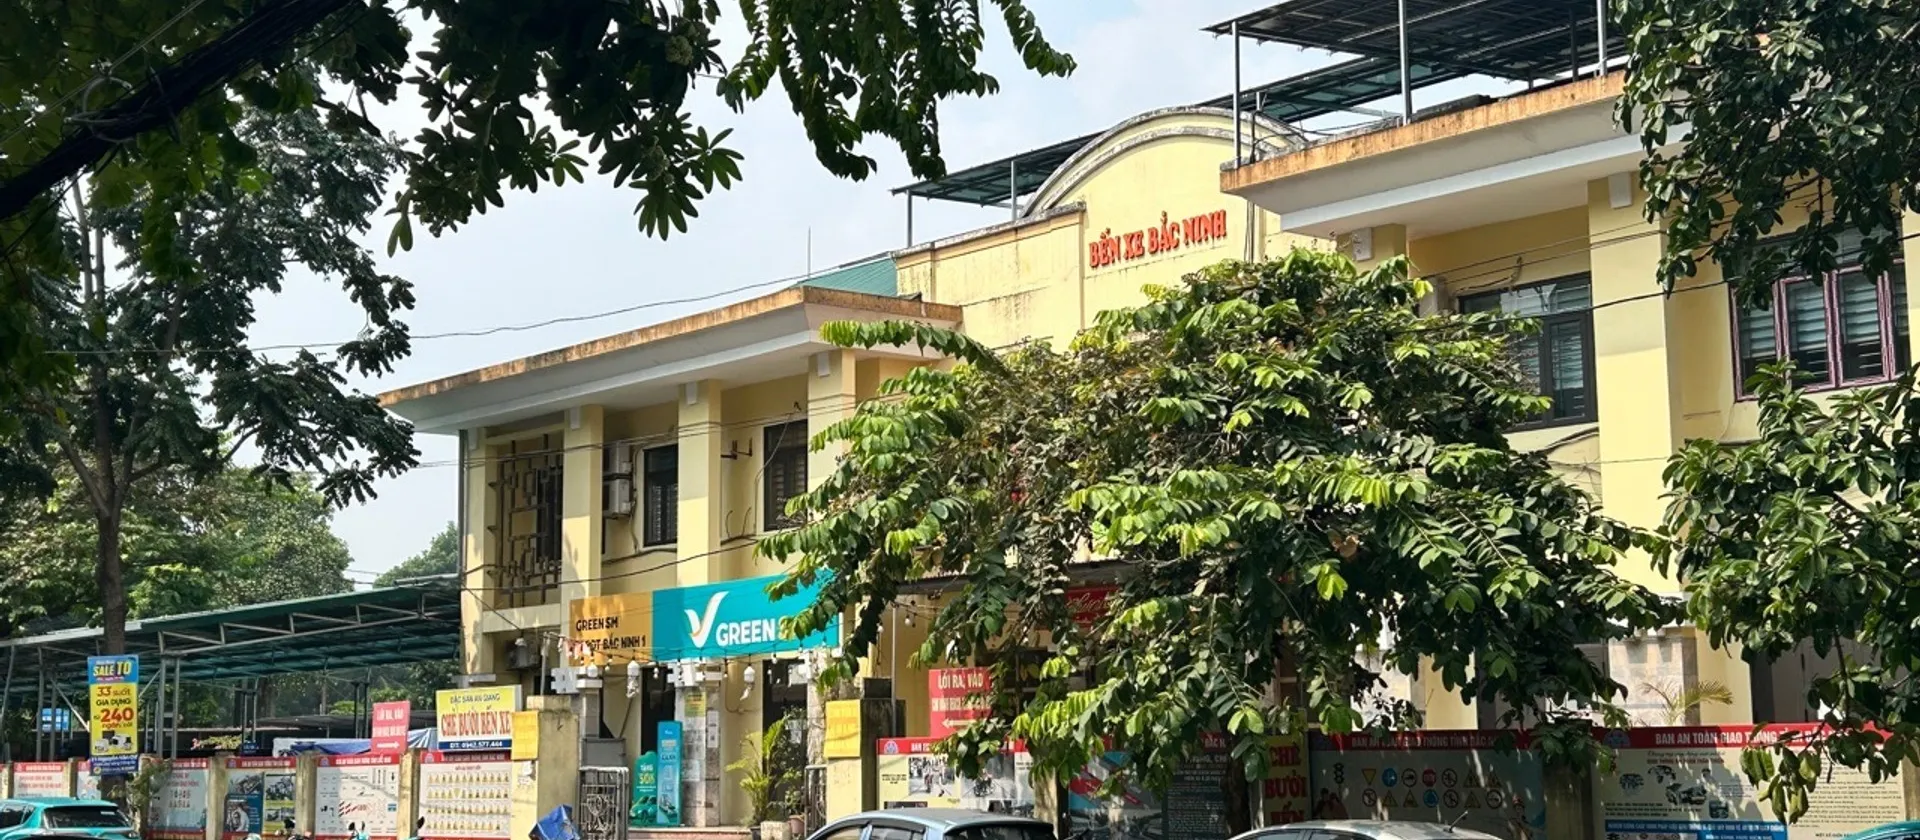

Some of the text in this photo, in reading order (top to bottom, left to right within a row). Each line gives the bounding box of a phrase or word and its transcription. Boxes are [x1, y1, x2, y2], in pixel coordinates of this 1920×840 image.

[1089, 209, 1227, 268] BẾN XE BẮC NINH
[576, 616, 618, 631] GREEN SM
[715, 618, 776, 646] GREEN
[603, 633, 620, 650] BẮC
[621, 636, 640, 648] NINH
[641, 635, 646, 647] 1
[93, 665, 115, 677] SALE
[938, 670, 951, 689] LỐI
[967, 670, 983, 688] VÀO
[96, 686, 112, 697] 33
[100, 706, 134, 722] 240
[498, 710, 511, 735] XE
[1655, 732, 1675, 745] BAN
[1677, 732, 1691, 744] AN
[1693, 729, 1718, 744] TOÀN
[1720, 730, 1743, 743] GIAO
